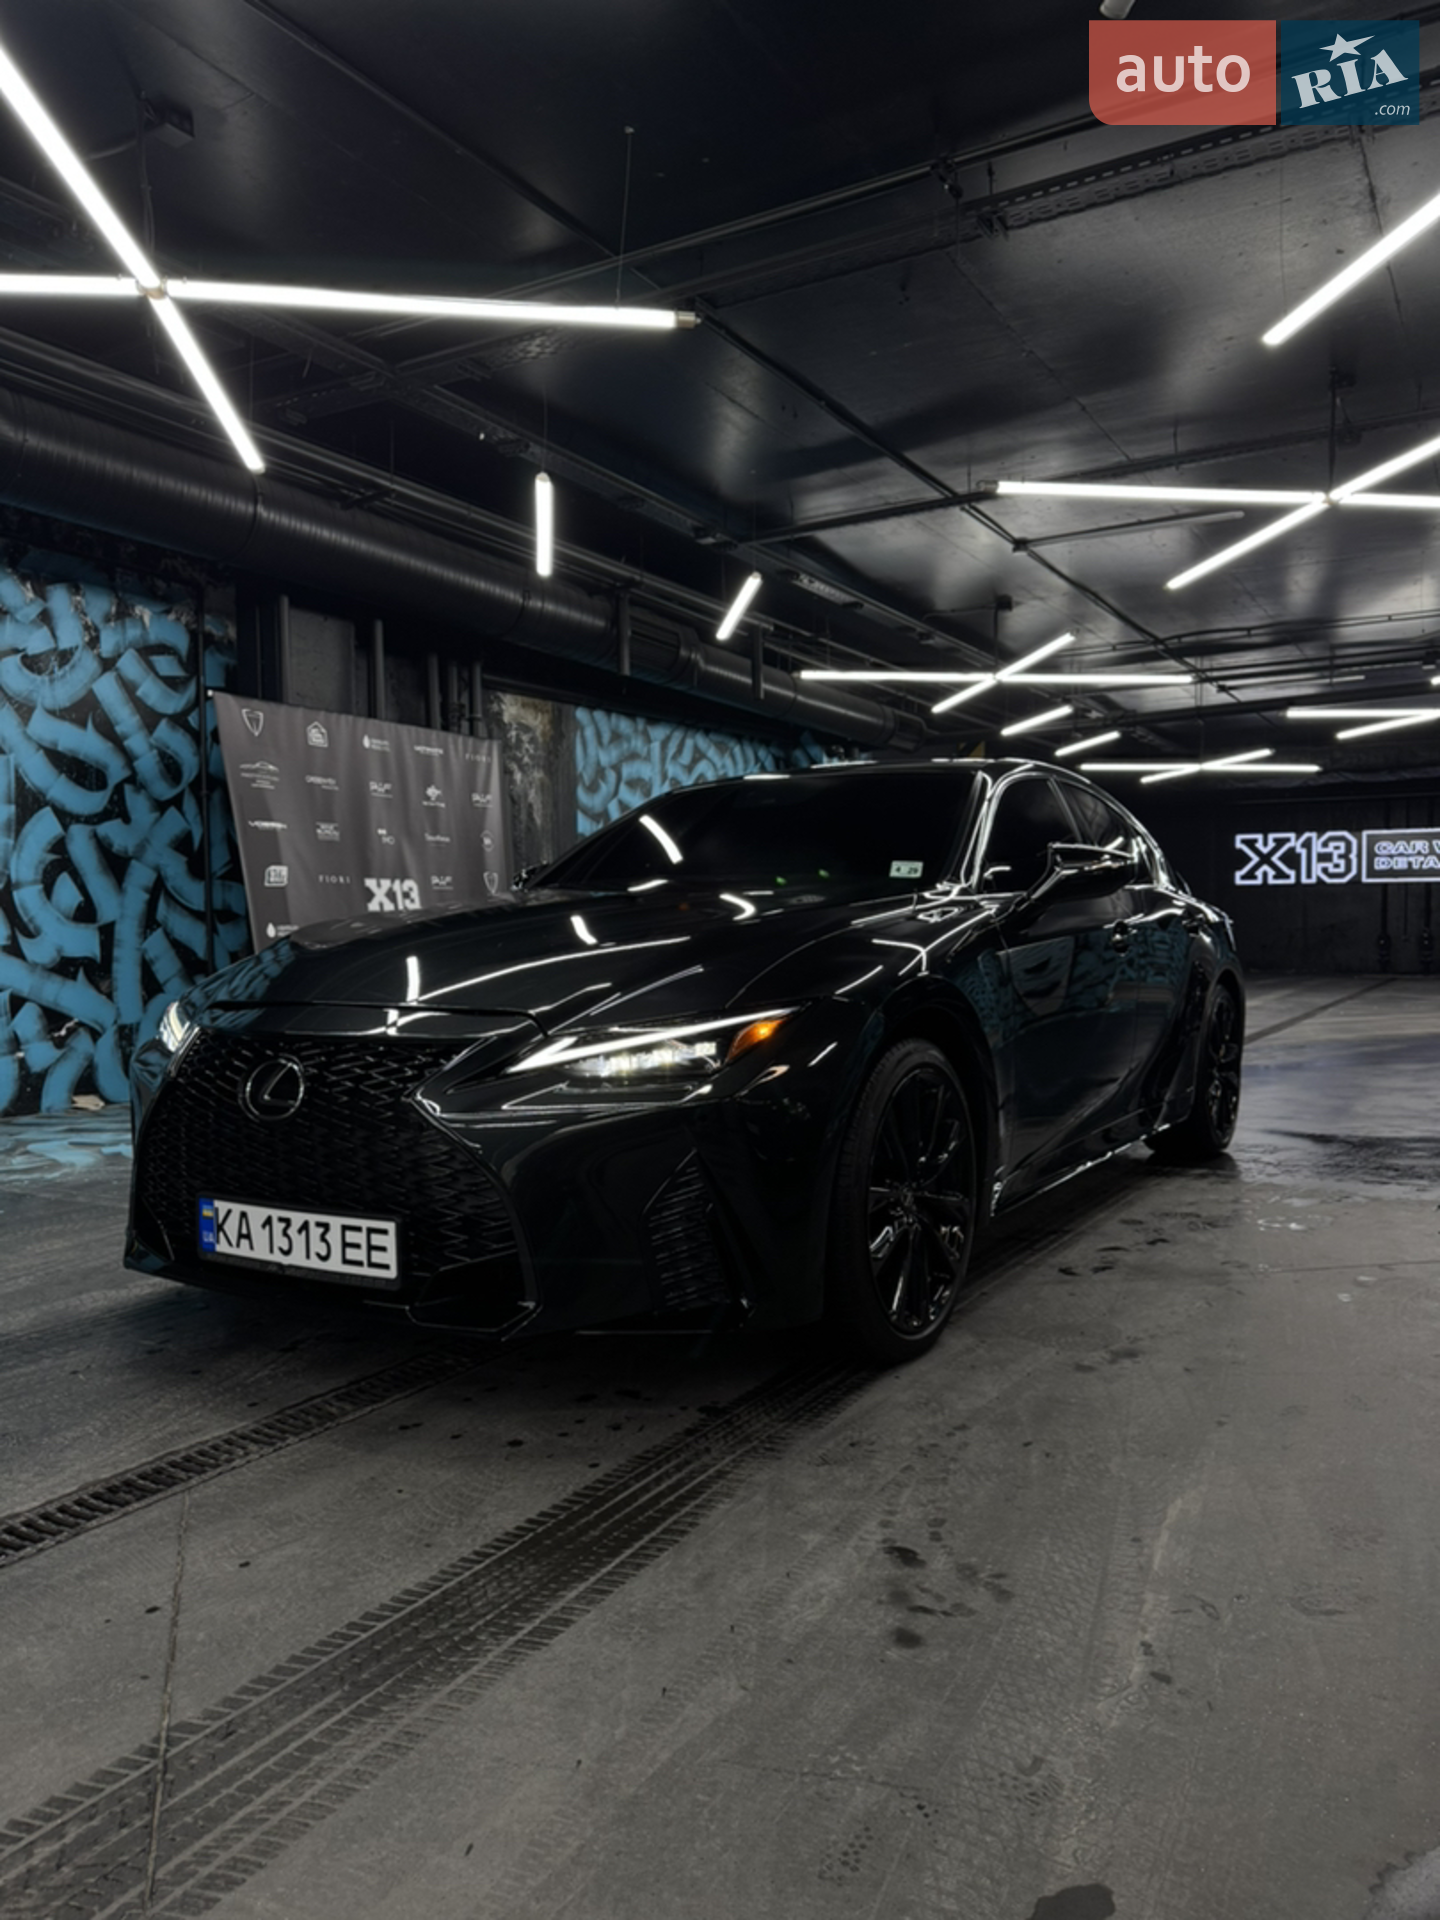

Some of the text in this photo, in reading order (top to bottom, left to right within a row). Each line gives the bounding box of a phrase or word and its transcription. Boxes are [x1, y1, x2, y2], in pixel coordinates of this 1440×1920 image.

[1234, 830, 1358, 886] X13
[1374, 841, 1430, 855] CAR
[318, 874, 352, 885] FIORI
[364, 878, 422, 912] X13
